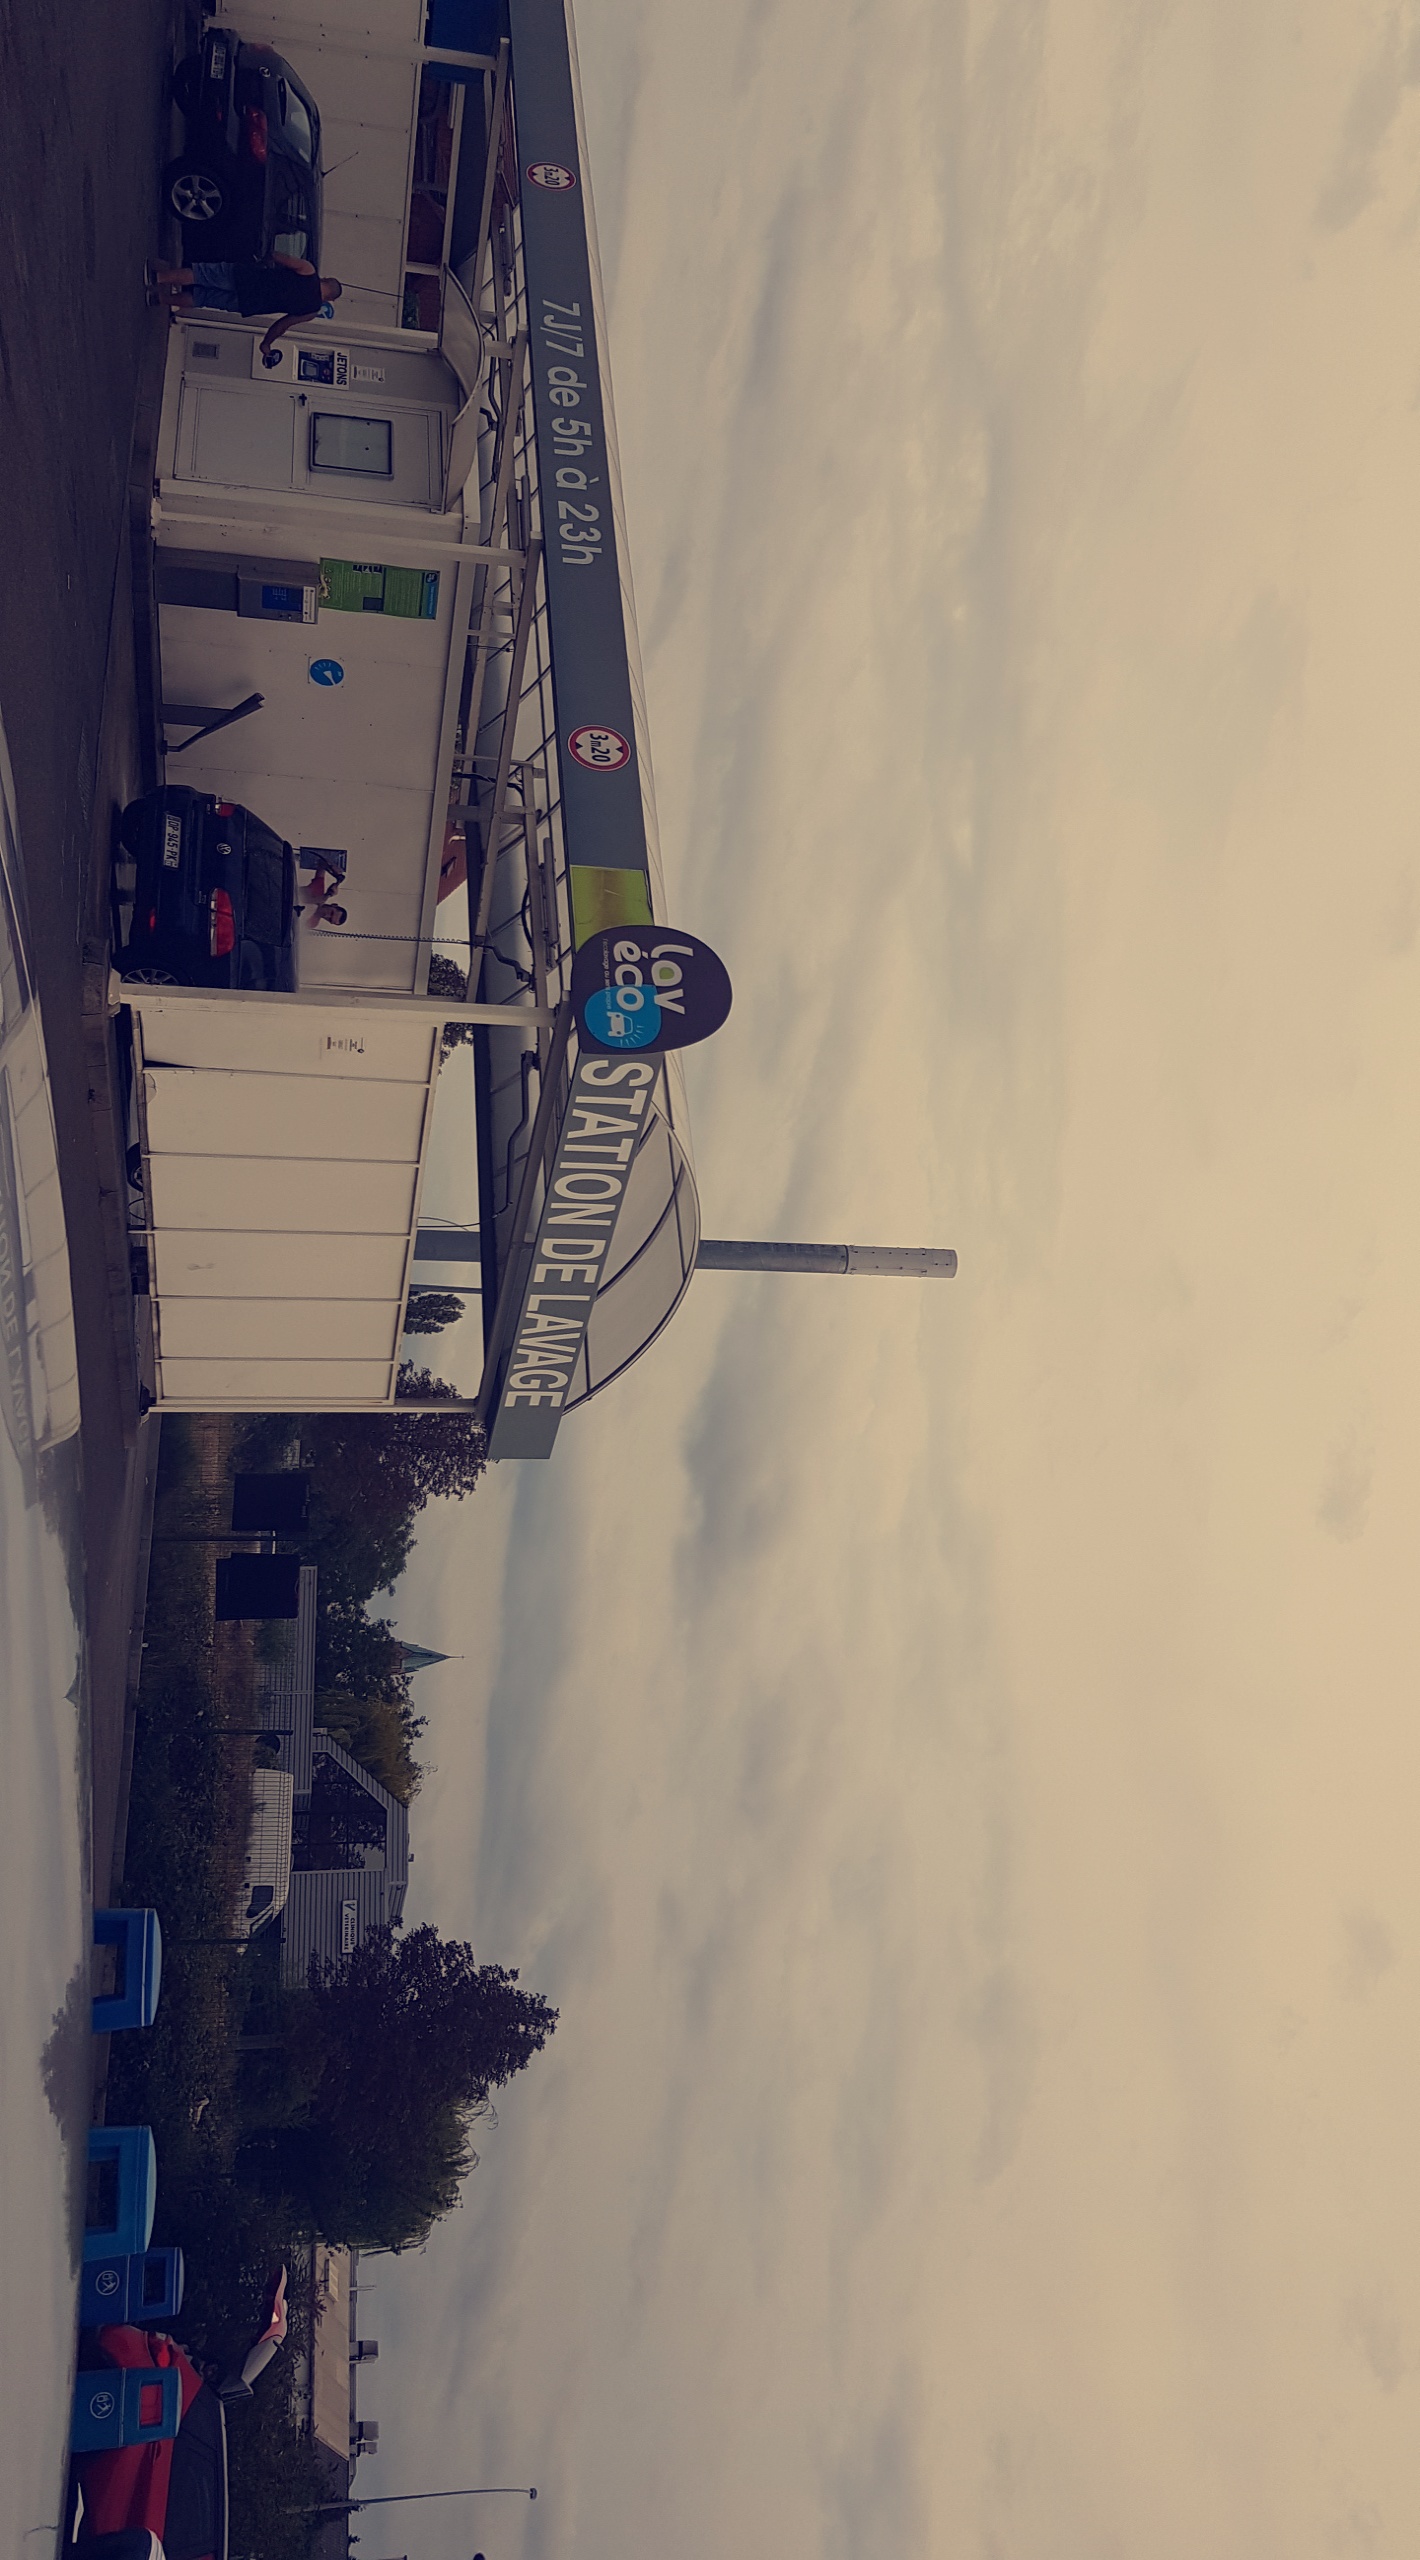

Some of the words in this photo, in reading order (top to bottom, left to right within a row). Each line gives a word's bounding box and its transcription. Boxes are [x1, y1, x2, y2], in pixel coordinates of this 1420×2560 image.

[540, 300, 584, 358] 7J/7
[336, 352, 348, 386] JETONS
[547, 366, 587, 408] de
[551, 417, 595, 457] 5h
[556, 467, 599, 492] à
[556, 501, 602, 565] 23h
[612, 940, 649, 1012] éco
[546, 1060, 654, 1227] STATION
[532, 1238, 606, 1284] DE
[504, 1294, 590, 1408] LAVAGE
